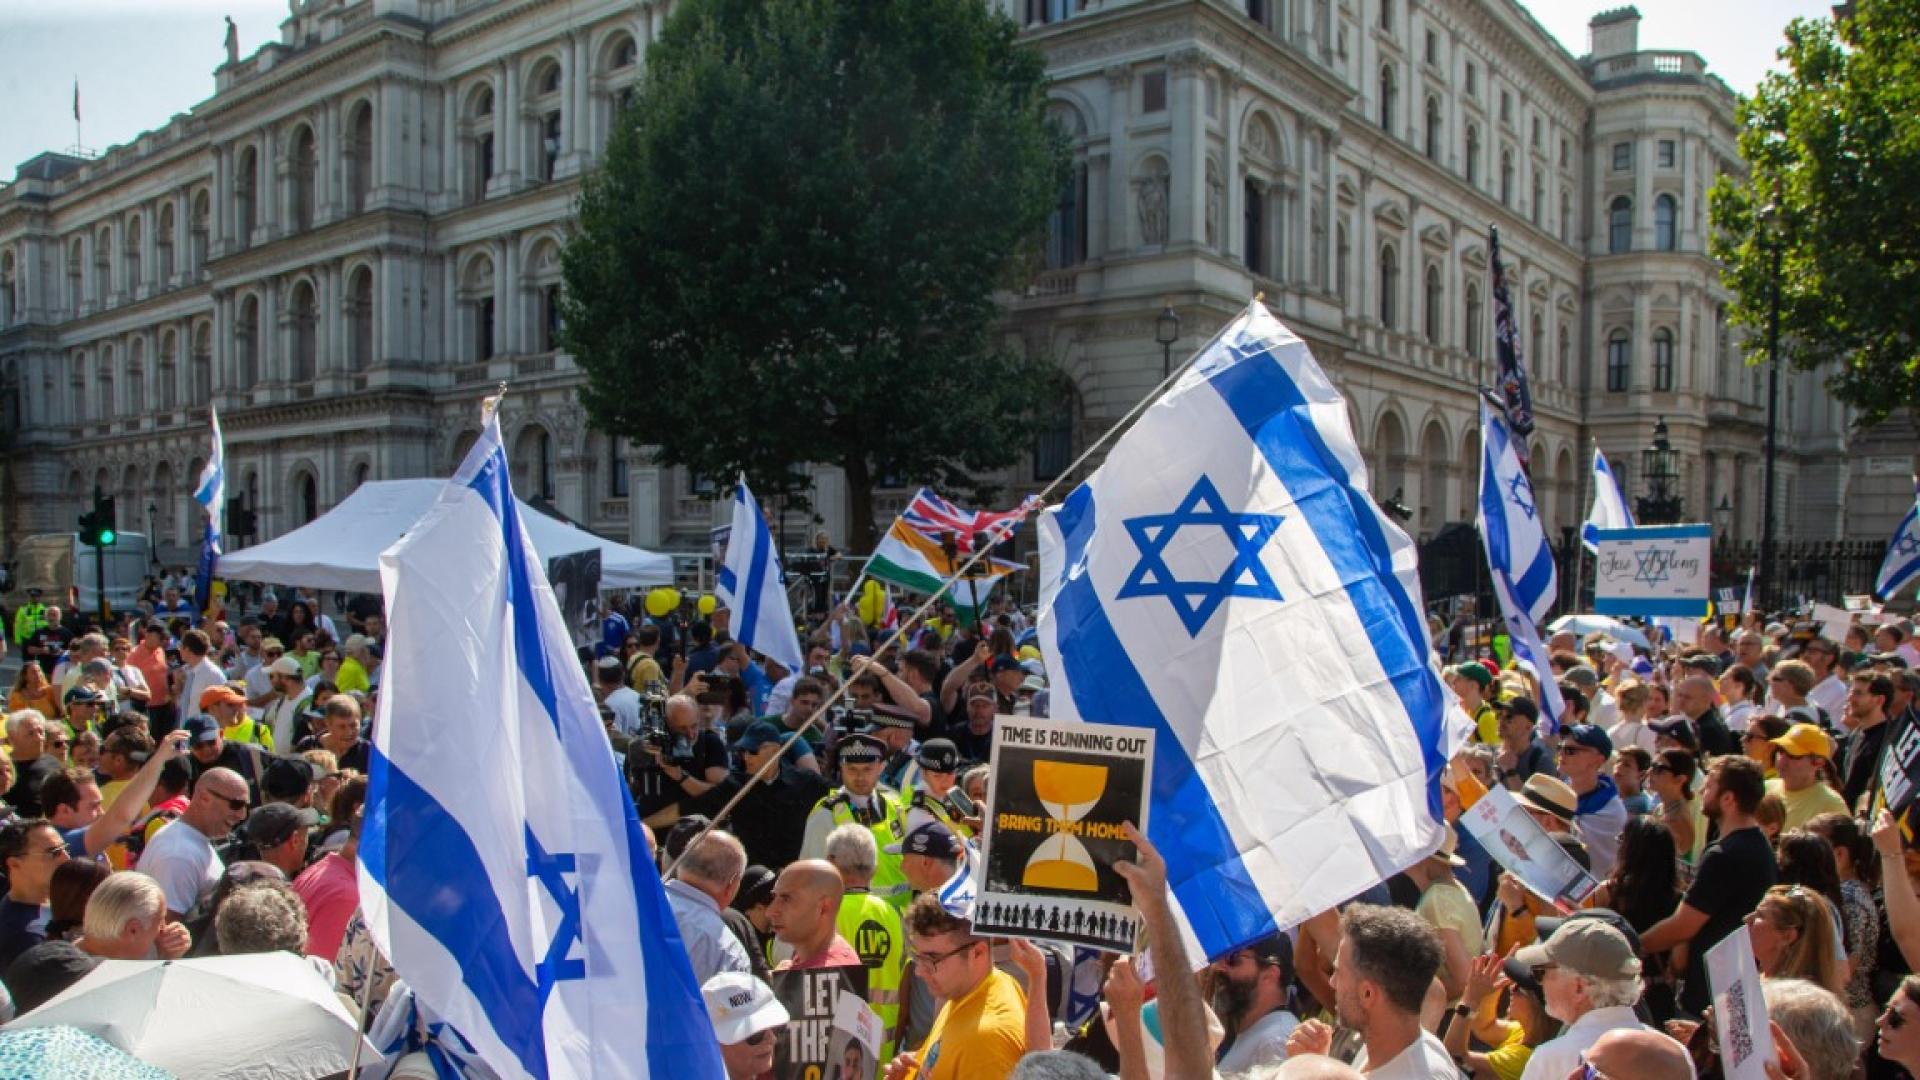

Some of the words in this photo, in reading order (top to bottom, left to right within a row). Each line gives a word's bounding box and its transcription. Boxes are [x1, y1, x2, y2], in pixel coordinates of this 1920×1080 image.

[1001, 726, 1031, 744] TIME
[1035, 729, 1046, 745] IS
[1050, 730, 1113, 750] RUNNING
[1116, 737, 1147, 753] OUT
[999, 813, 1042, 832] BRING
[1045, 818, 1081, 836] THEM
[860, 929, 888, 954] LVC
[803, 973, 840, 1016] LET
